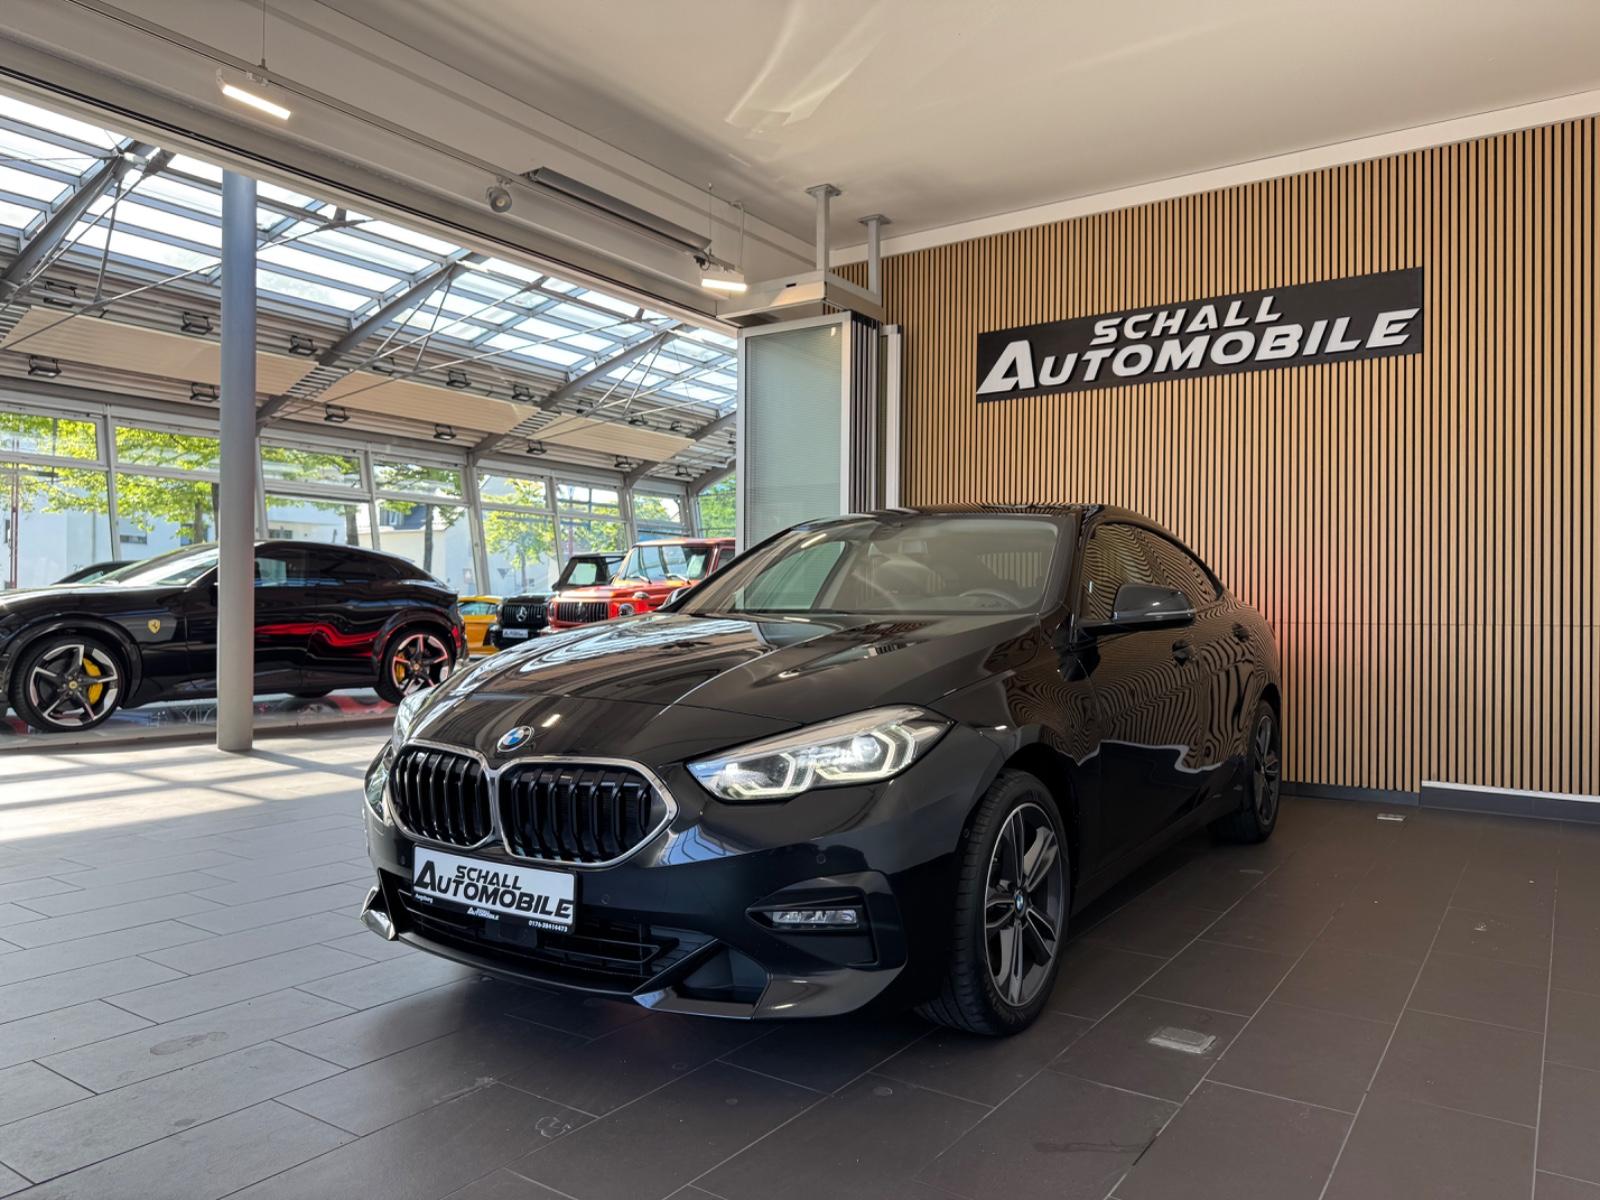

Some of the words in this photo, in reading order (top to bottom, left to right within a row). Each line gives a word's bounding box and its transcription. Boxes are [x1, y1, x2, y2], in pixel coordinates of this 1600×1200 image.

[1090, 295, 1283, 346] SCHALL
[975, 307, 1421, 394] AUTOMOBILE
[414, 860, 574, 918] AUTOMOBILE
[455, 865, 522, 890] SCHALL
